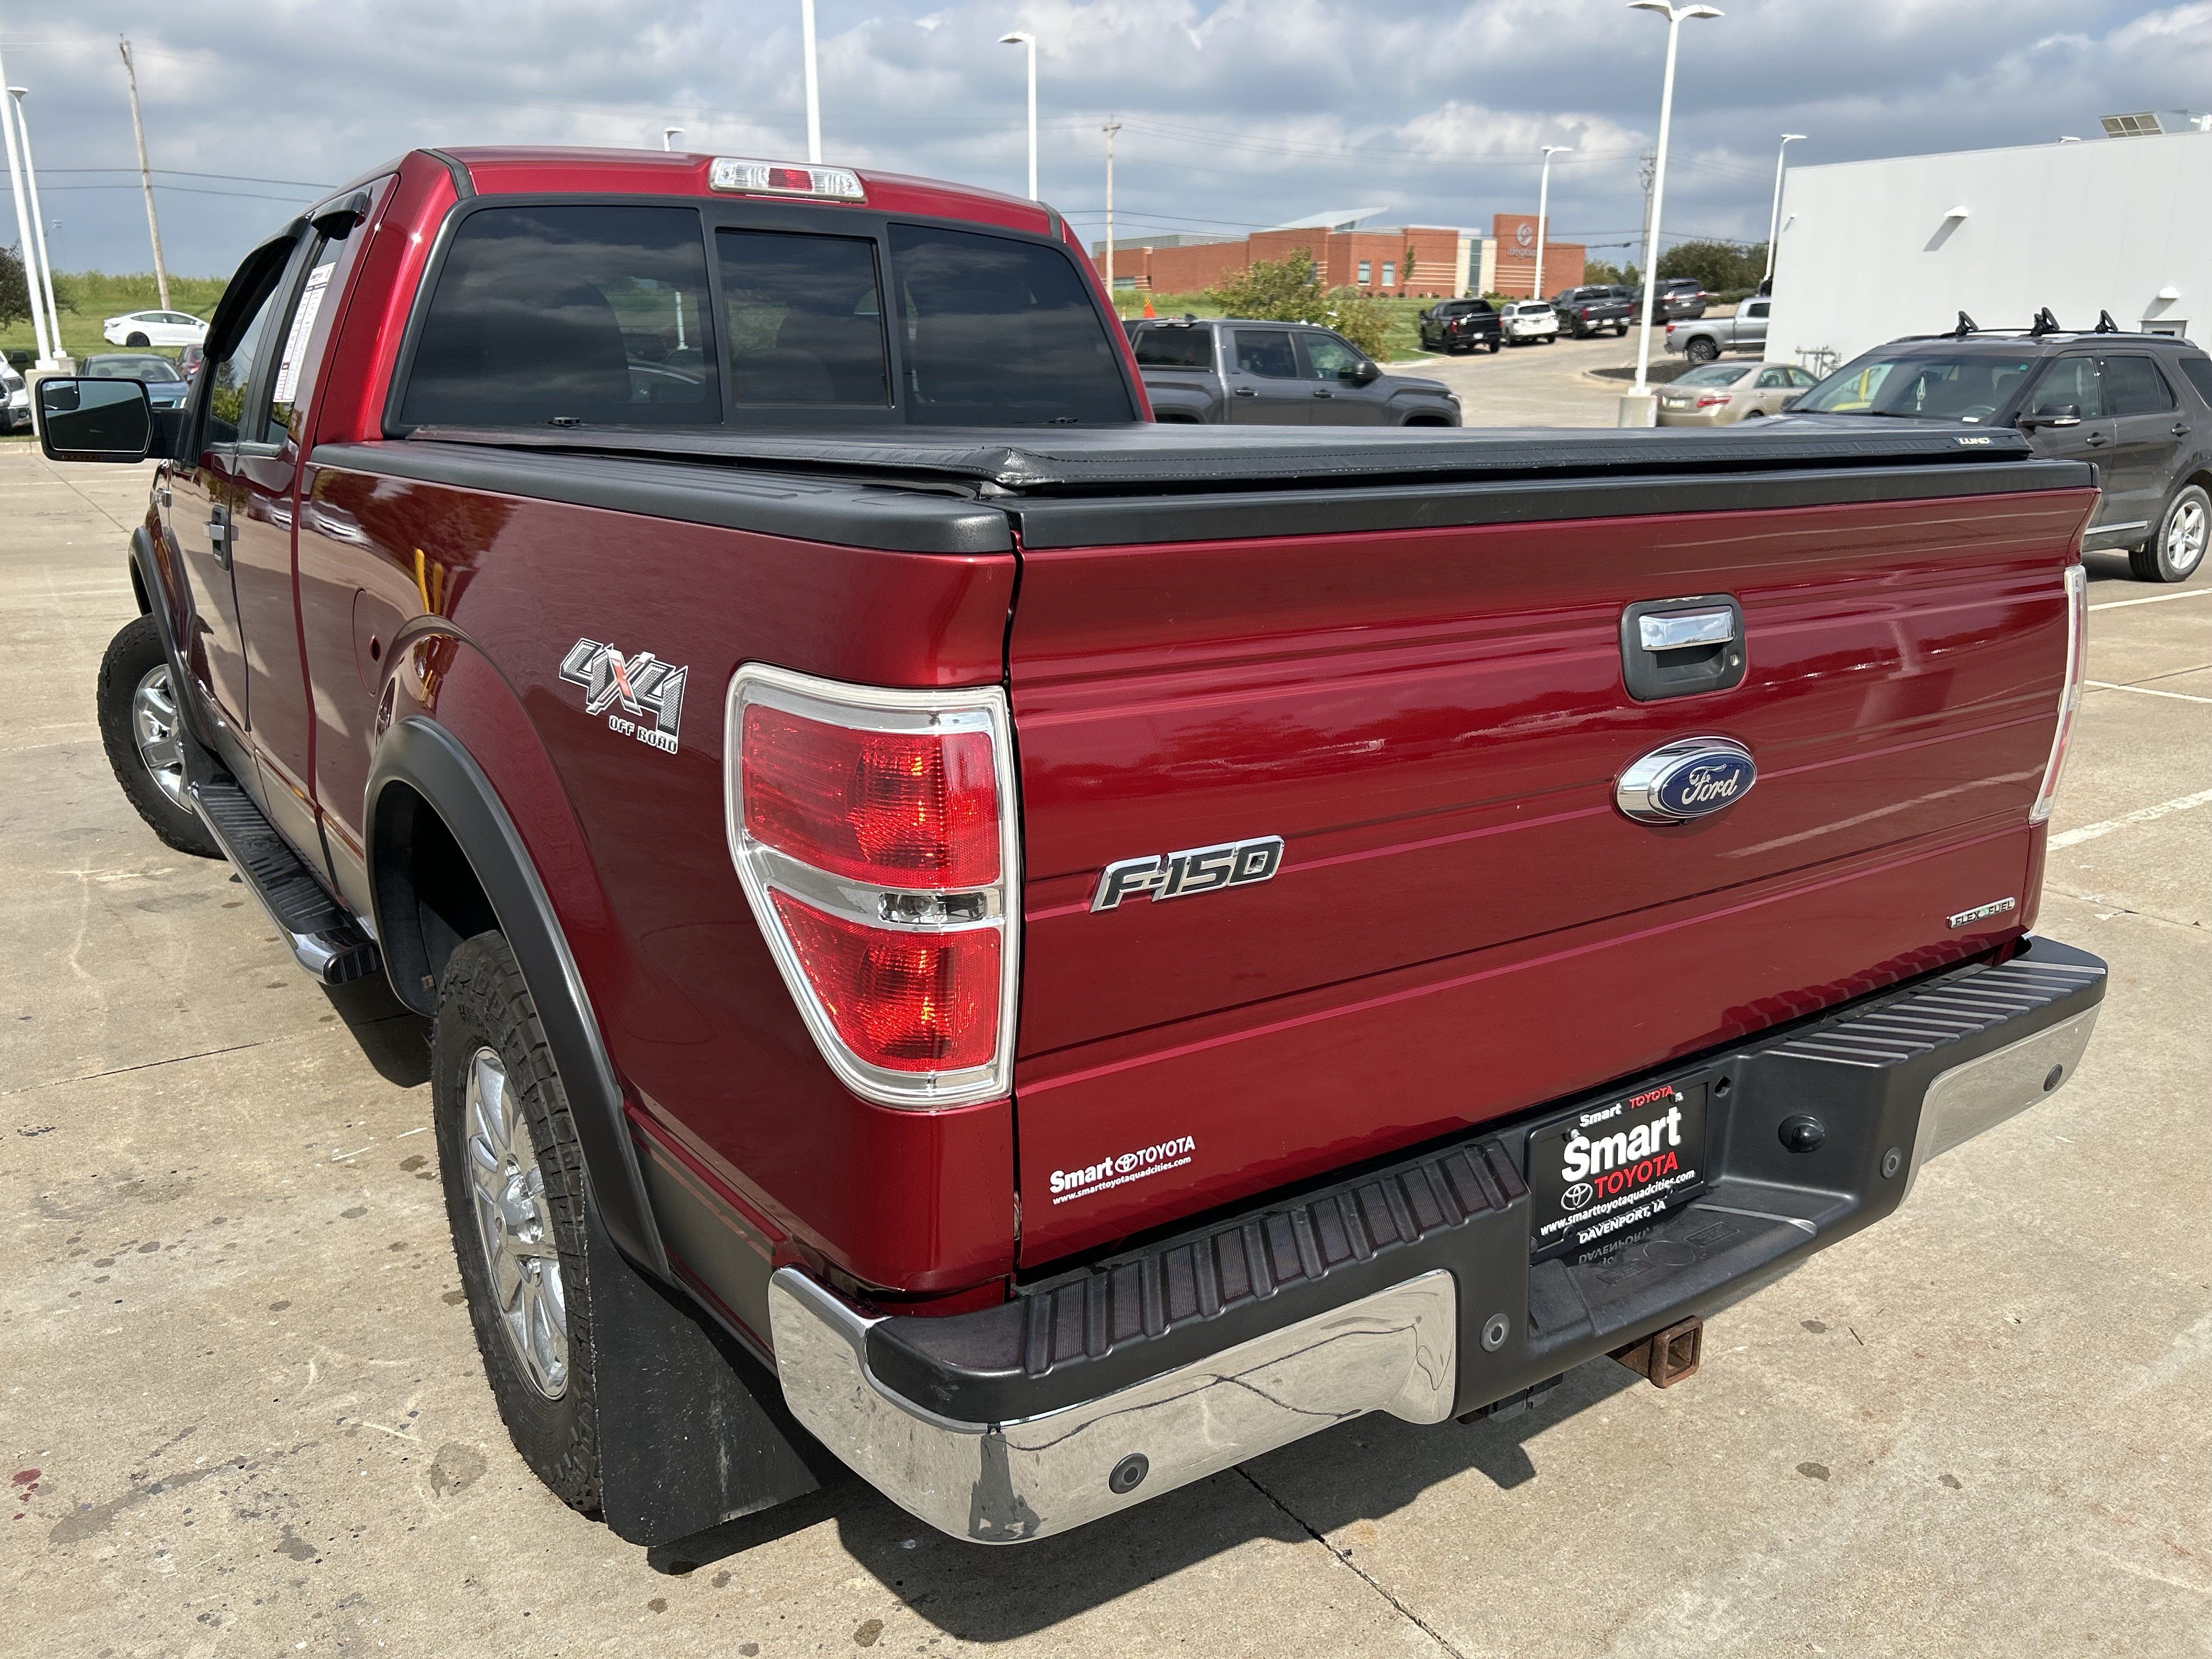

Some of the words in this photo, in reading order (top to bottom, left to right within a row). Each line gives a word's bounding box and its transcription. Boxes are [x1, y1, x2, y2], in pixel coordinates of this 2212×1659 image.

[609, 715, 635, 736] OFF
[637, 726, 679, 754] ROAD
[1681, 764, 1740, 805] Ford
[1090, 834, 1284, 913] F-150
[1955, 911, 1980, 926] FLEX
[1988, 900, 2013, 916] FUEL
[1579, 1103, 1622, 1127] Smart
[1629, 1085, 1673, 1109] TOYOTA
[1049, 1156, 1113, 1193] Smart
[1136, 1135, 1196, 1165] TOYOTA
[1562, 1107, 1681, 1182] Smart
[1052, 1156, 1192, 1205] www.smarttoyotaquadcities.com
[1594, 1152, 1678, 1198] TOYOTA
[1540, 1170, 1695, 1236] www.smarttoyotaquadcities.com
[1578, 1206, 1651, 1244] DAVENPORT,
[1653, 1199, 1666, 1214] IA
